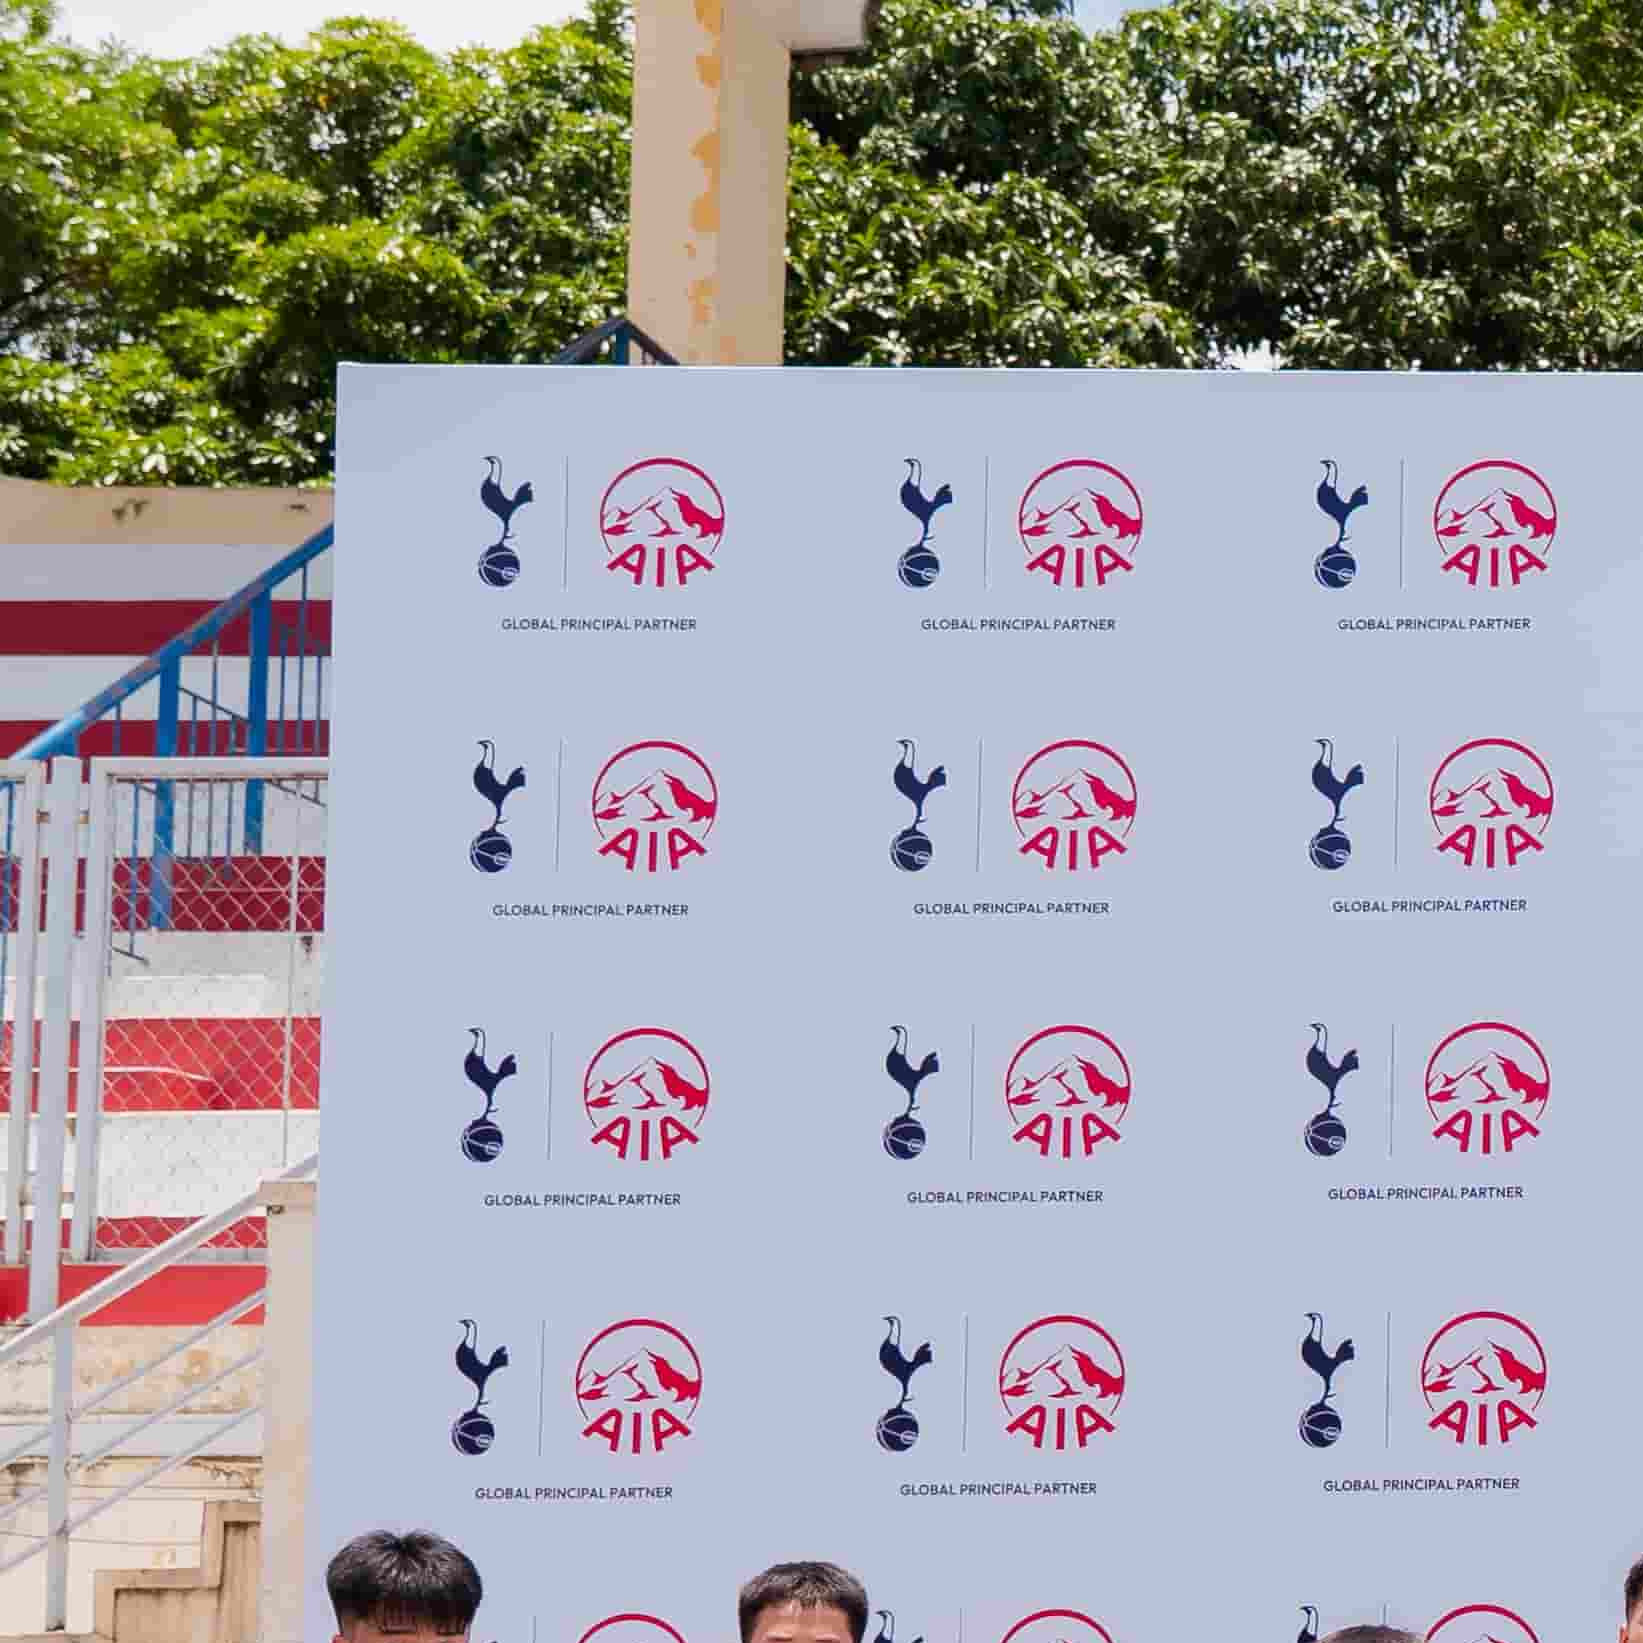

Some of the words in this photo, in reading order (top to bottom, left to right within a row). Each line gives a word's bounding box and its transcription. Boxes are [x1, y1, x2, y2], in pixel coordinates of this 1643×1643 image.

[606, 543, 714, 588] AIA
[1024, 543, 1134, 589] AIA
[1440, 543, 1548, 588] AIA
[501, 618, 558, 631] GLOBAL
[560, 618, 632, 631] PRINCIPAL
[634, 618, 697, 631] PARTNER
[1338, 618, 1394, 631] GLOBAL
[1396, 618, 1467, 631] PRINCIPAL
[1469, 617, 1531, 630] PARTNER
[1020, 825, 1127, 872] AIA
[913, 903, 970, 915] GLOBAL
[972, 902, 1044, 914] PRINCIPAL
[1046, 902, 1109, 914] PARTNER
[1431, 1108, 1541, 1154] AIA
[1327, 1187, 1384, 1201] GLOBAL
[1386, 1186, 1458, 1199] PRINCIPAL
[1460, 1186, 1523, 1199] PARTNER
[581, 1407, 690, 1455] AIA
[1427, 1399, 1538, 1447] AIA
[475, 1487, 533, 1500] GLOBAL
[534, 1487, 608, 1500] PRINCIPAL
[609, 1486, 673, 1499] PARTNER
[1323, 1479, 1381, 1492] GLOBAL
[1382, 1478, 1455, 1491] PRINCIPAL
[1456, 1477, 1520, 1491] PARTNER
